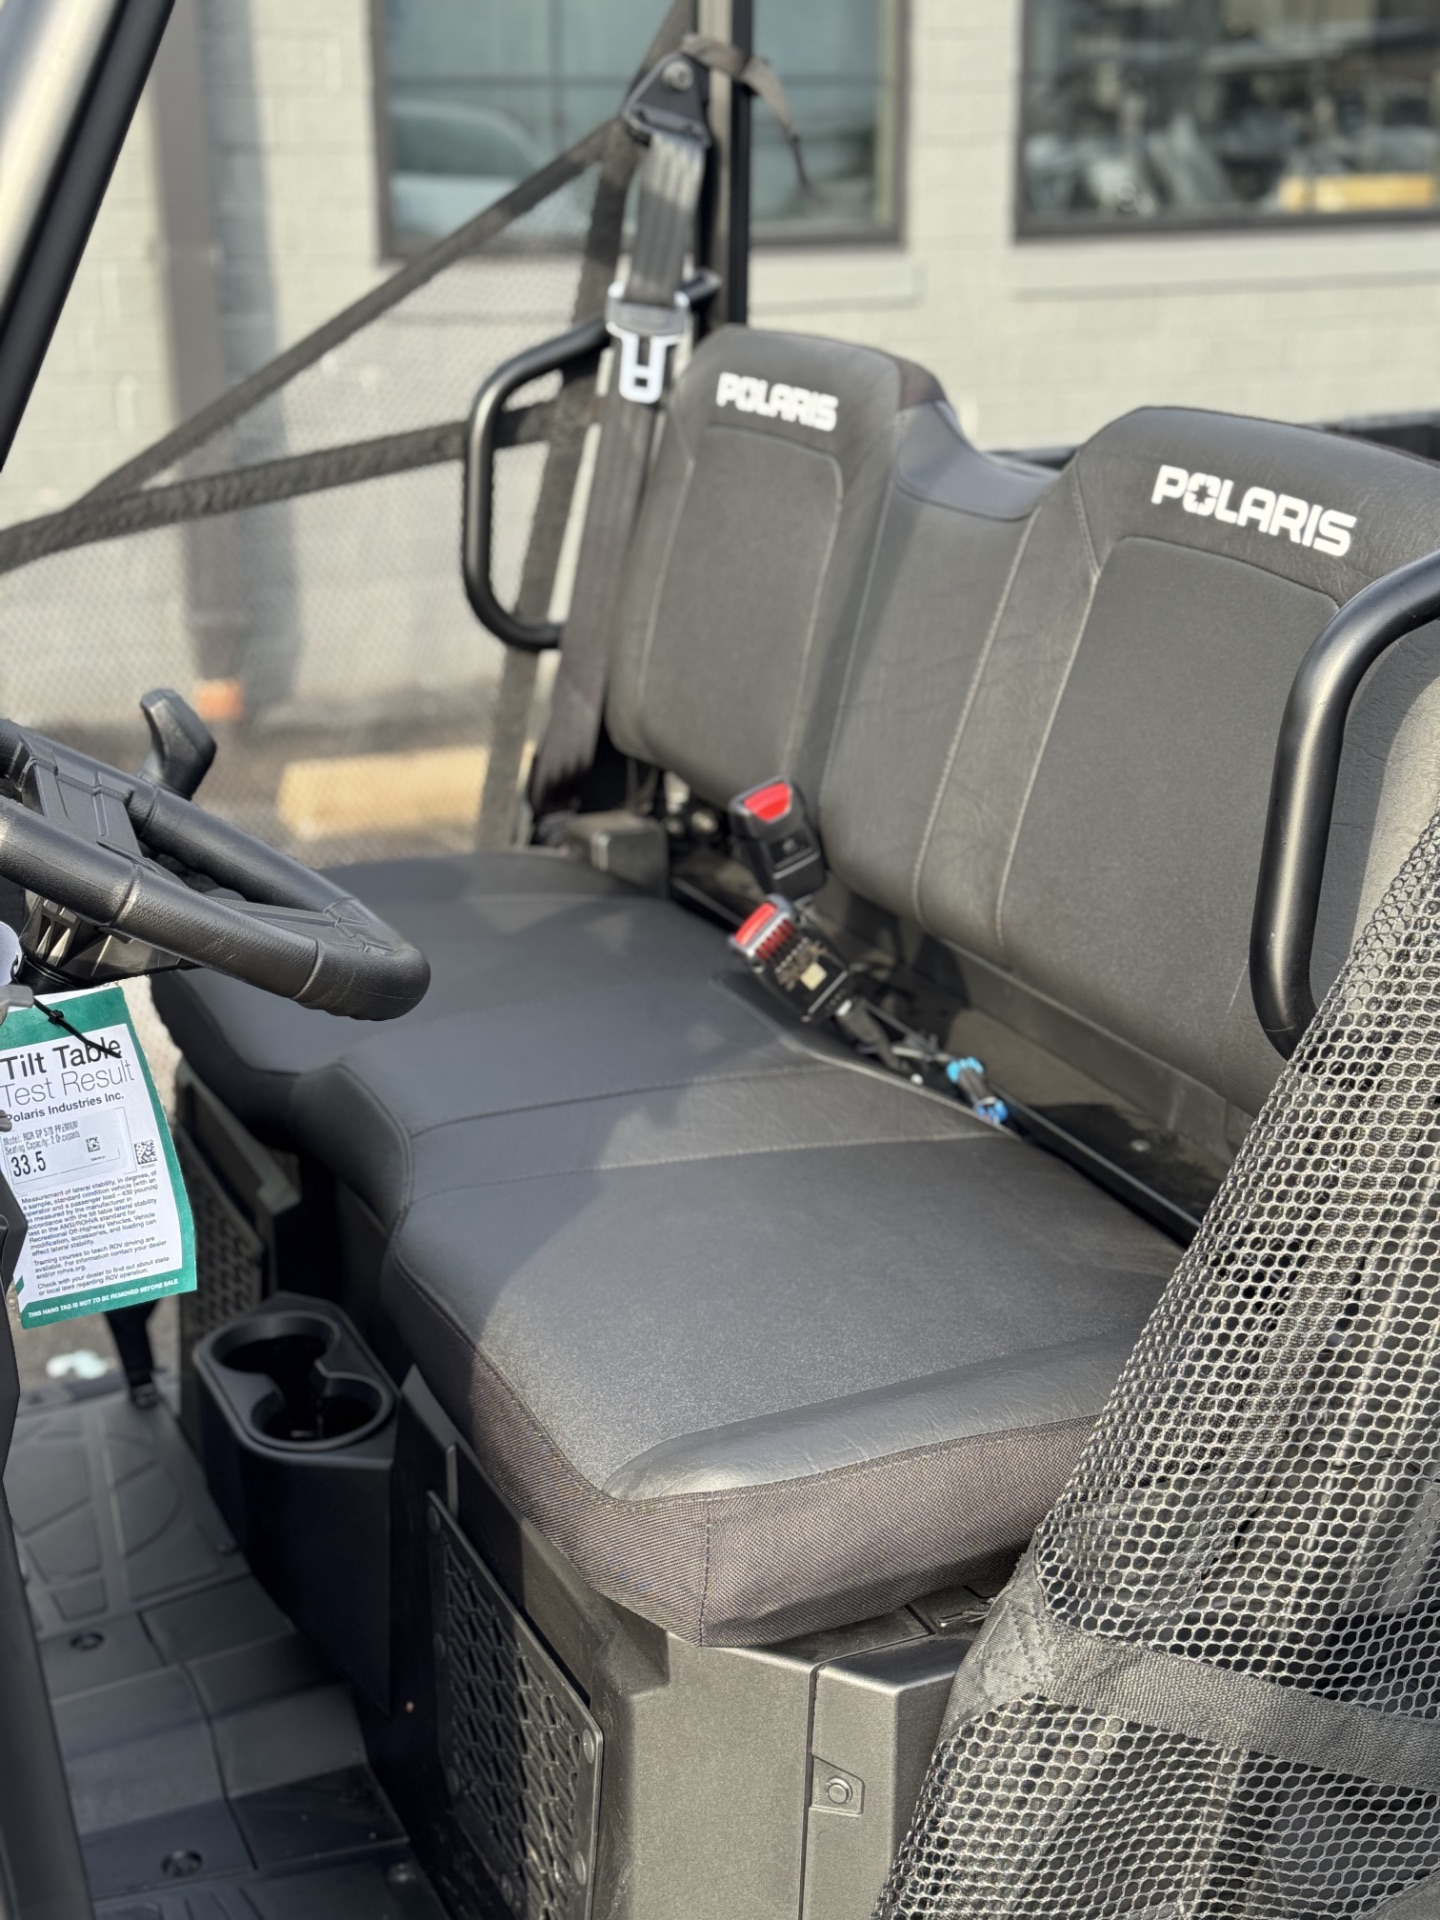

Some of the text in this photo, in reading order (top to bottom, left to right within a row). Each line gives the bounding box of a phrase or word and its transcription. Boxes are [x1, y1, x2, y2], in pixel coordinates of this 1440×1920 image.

[716, 372, 838, 431] POLARIS
[1151, 465, 1356, 557] POLARIS
[0, 1037, 121, 1080] Tilt Table
[0, 1060, 135, 1107] Test Result
[48, 1097, 102, 1115] Industries
[104, 1092, 124, 1103] Inc.
[3, 1134, 21, 1145] Model:
[35, 1129, 42, 1139] SP
[11, 1151, 46, 1177] 33.5
[21, 1190, 64, 1204] Measurement
[72, 1185, 91, 1193] lateral
[92, 1180, 116, 1189] stability,
[124, 1173, 150, 1182] degrees,
[28, 1201, 53, 1210] sample,
[54, 1193, 81, 1204] standard
[82, 1188, 110, 1198] condition
[111, 1183, 132, 1192] vehicle
[133, 1179, 148, 1188] (with
[34, 1210, 65, 1222] measured
[85, 1198, 125, 1210] manufacturer
[99, 1211, 126, 1222] standard
[114, 1203, 133, 1211] lateral
[134, 1198, 157, 1207] stability
[29, 1231, 67, 1243] Recreational
[68, 1224, 105, 1235] Off-Highway
[133, 1212, 155, 1221] Vehicle
[32, 1239, 94, 1256] affect lateral stability.
[33, 1257, 58, 1266] Training
[58, 1252, 83, 1261] courses
[91, 1246, 108, 1254] teach
[109, 1242, 123, 1250] ROV
[124, 1239, 145, 1247] driving
[35, 1263, 63, 1273] available.
[75, 1253, 109, 1264] information
[110, 1248, 133, 1257] contact
[134, 1245, 147, 1253] your
[148, 1240, 167, 1249] dealer
[37, 1281, 57, 1290] Check
[71, 1275, 85, 1283] your
[86, 1271, 104, 1279] dealer
[136, 1260, 154, 1268] about
[46, 1286, 61, 1294] local
[76, 1278, 104, 1288] regarding
[119, 1268, 148, 1279] operation.
[28, 1310, 41, 1318] THIS
[42, 1306, 59, 1315] HANG
[60, 1303, 72, 1311] TAG
[110, 1288, 139, 1299] REMOVED
[140, 1283, 163, 1292] BEFORE
